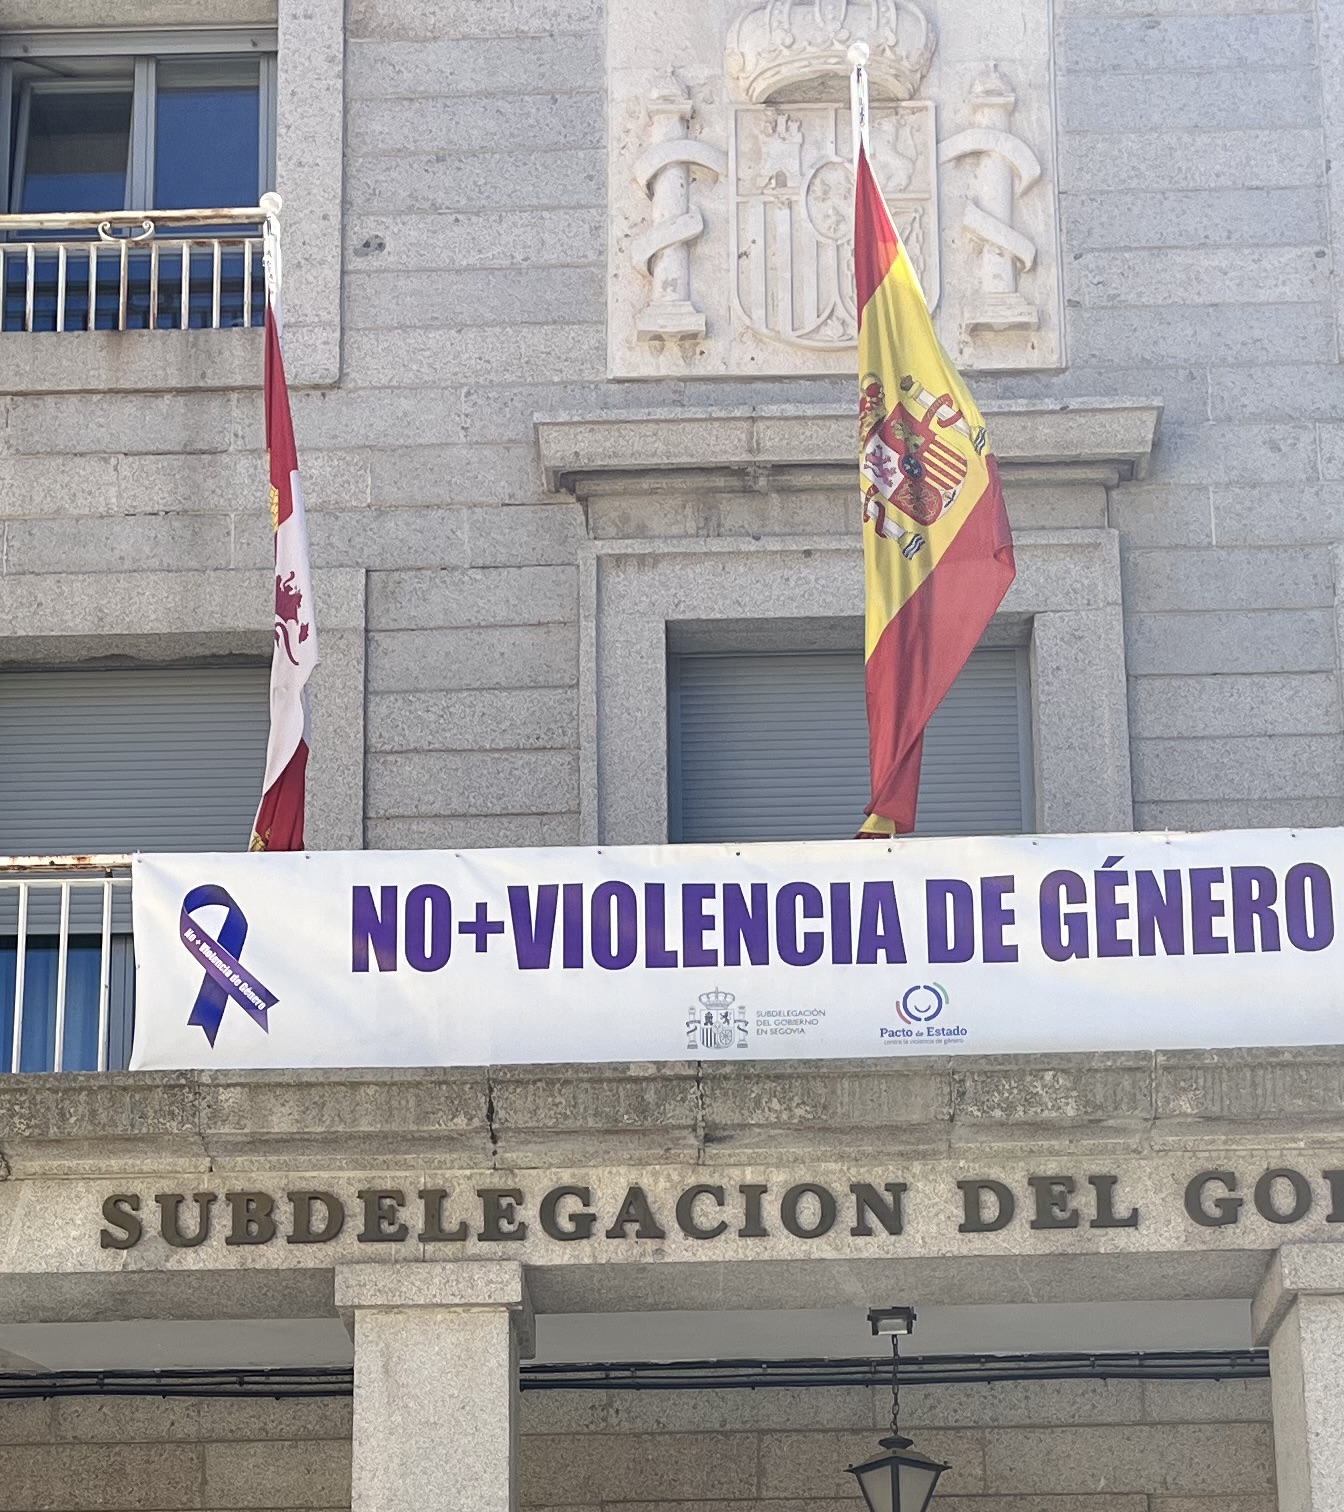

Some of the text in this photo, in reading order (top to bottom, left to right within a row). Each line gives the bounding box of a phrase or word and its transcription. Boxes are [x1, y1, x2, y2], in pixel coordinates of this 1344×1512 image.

[352, 856, 1334, 972] NO+VIOLENCIA DE GÉNERO
[774, 1018, 819, 1026] GOBIERNO
[756, 1027, 806, 1036] EN SEGOVIA
[880, 1027, 913, 1038] Pacto
[927, 1025, 968, 1037] Estado
[100, 1182, 908, 1249] SUBDELEGACION
[956, 1175, 1139, 1233] DEL
